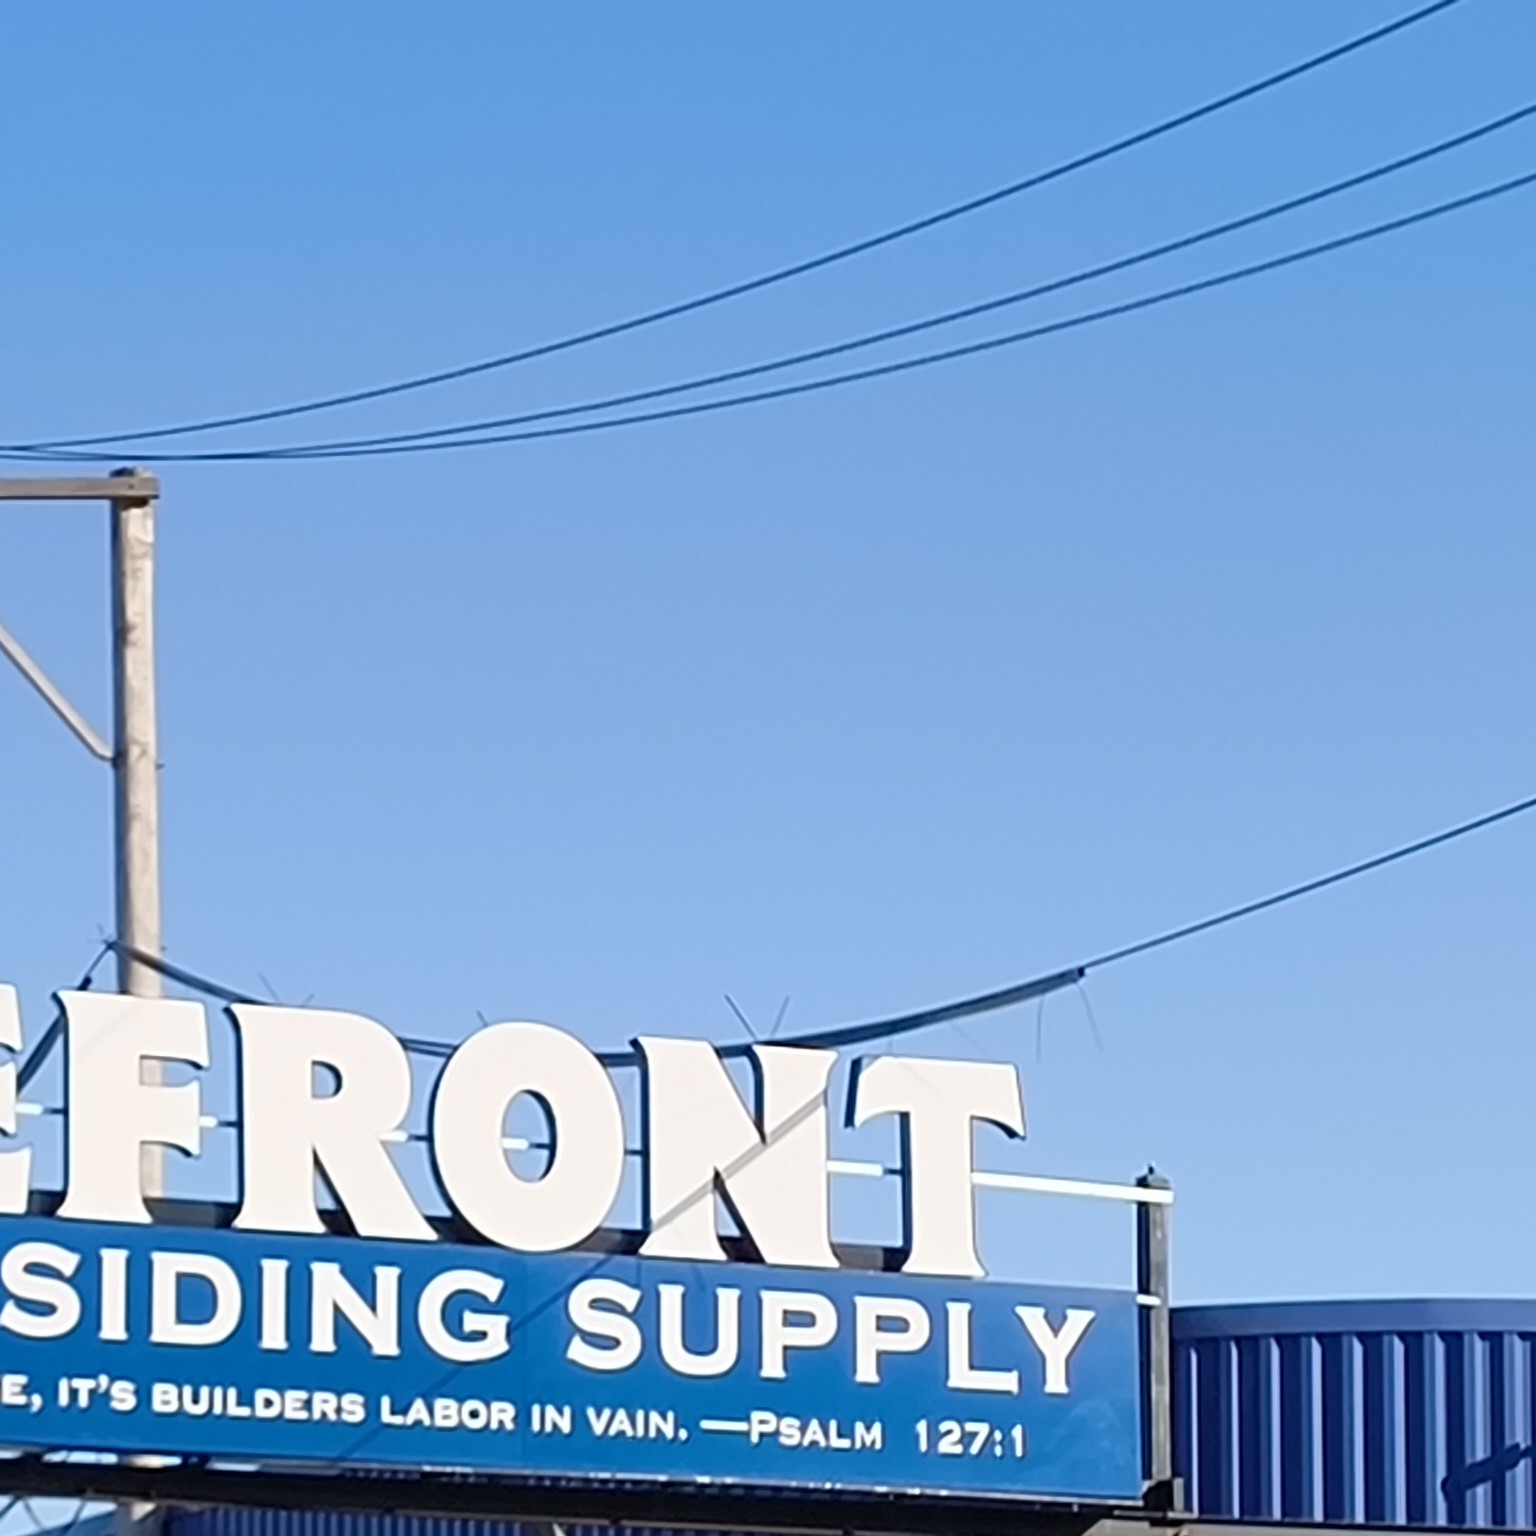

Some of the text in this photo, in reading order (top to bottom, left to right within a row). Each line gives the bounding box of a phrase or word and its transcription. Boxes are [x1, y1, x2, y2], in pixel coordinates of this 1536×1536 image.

[565, 1277, 1097, 1396] SUPPLY
[56, 1373, 138, 1412] IT'S
[151, 1381, 366, 1424] BUILDERS
[379, 1394, 517, 1432] LABOR
[530, 1403, 572, 1435] IN
[913, 1418, 1026, 1458] 127:1
